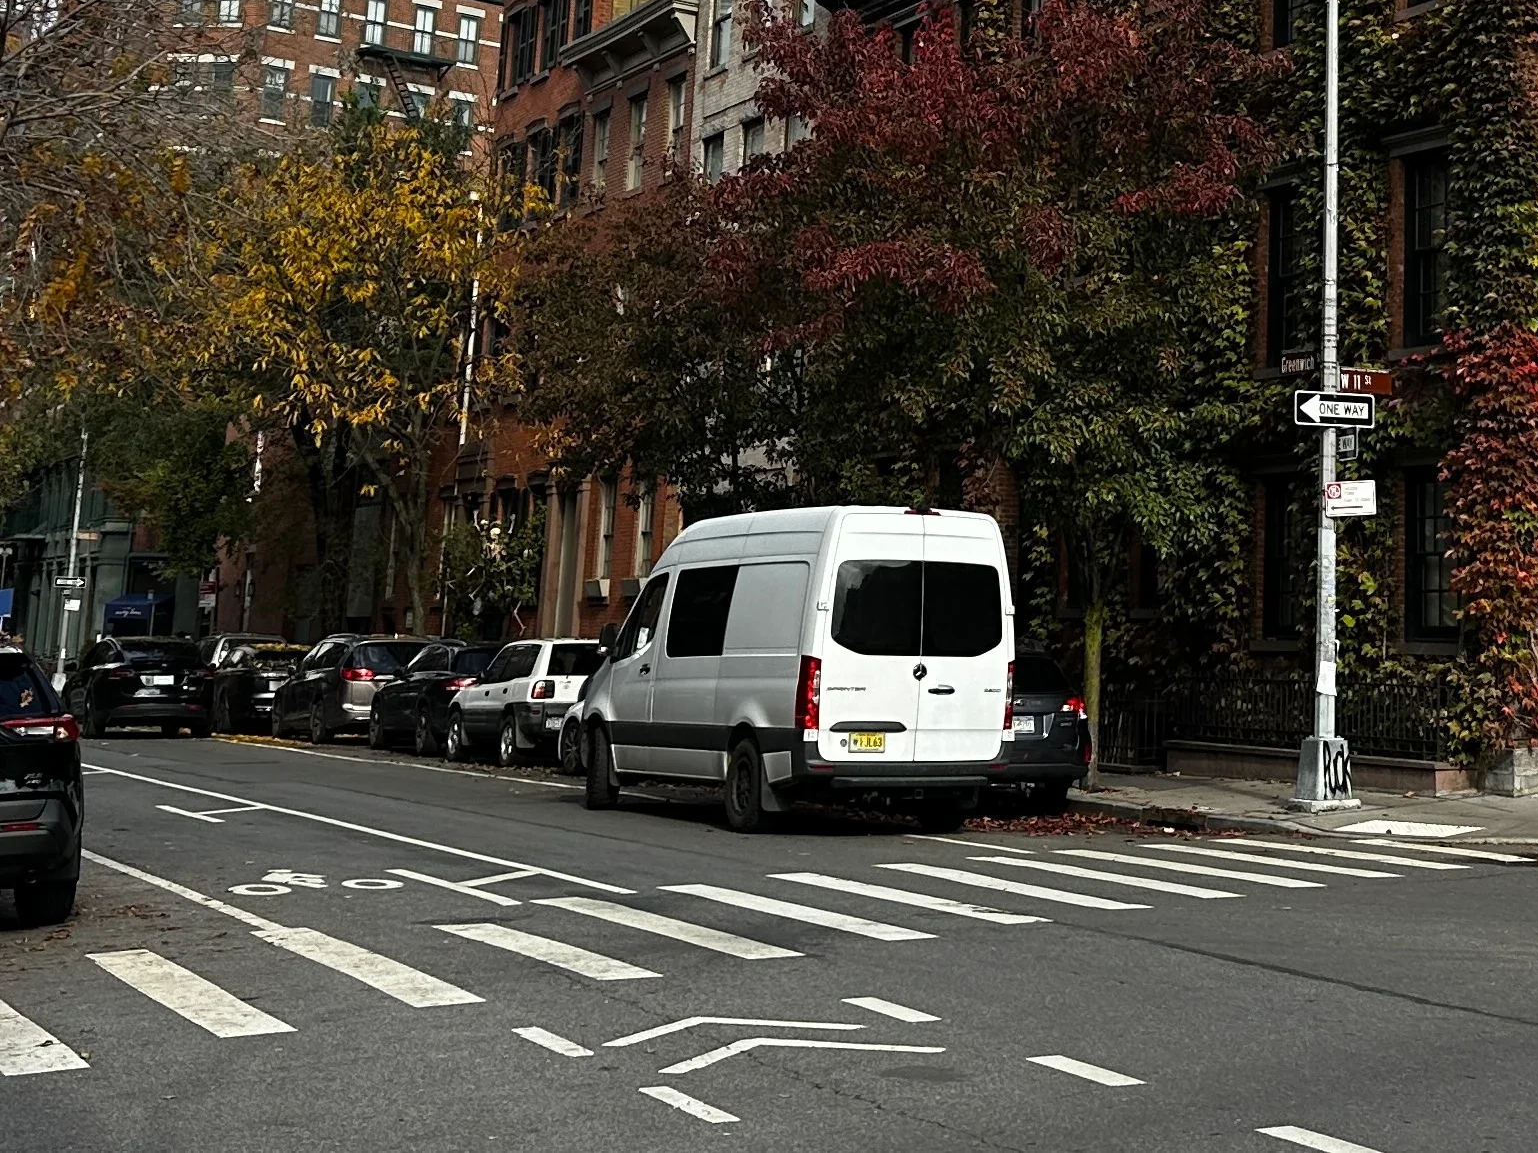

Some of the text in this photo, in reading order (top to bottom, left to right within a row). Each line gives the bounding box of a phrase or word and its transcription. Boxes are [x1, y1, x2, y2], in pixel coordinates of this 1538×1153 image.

[1281, 354, 1315, 374] Greenwich
[1341, 373, 1349, 389] W
[1353, 374, 1361, 390] 11
[1319, 402, 1365, 417] ONE WAY
